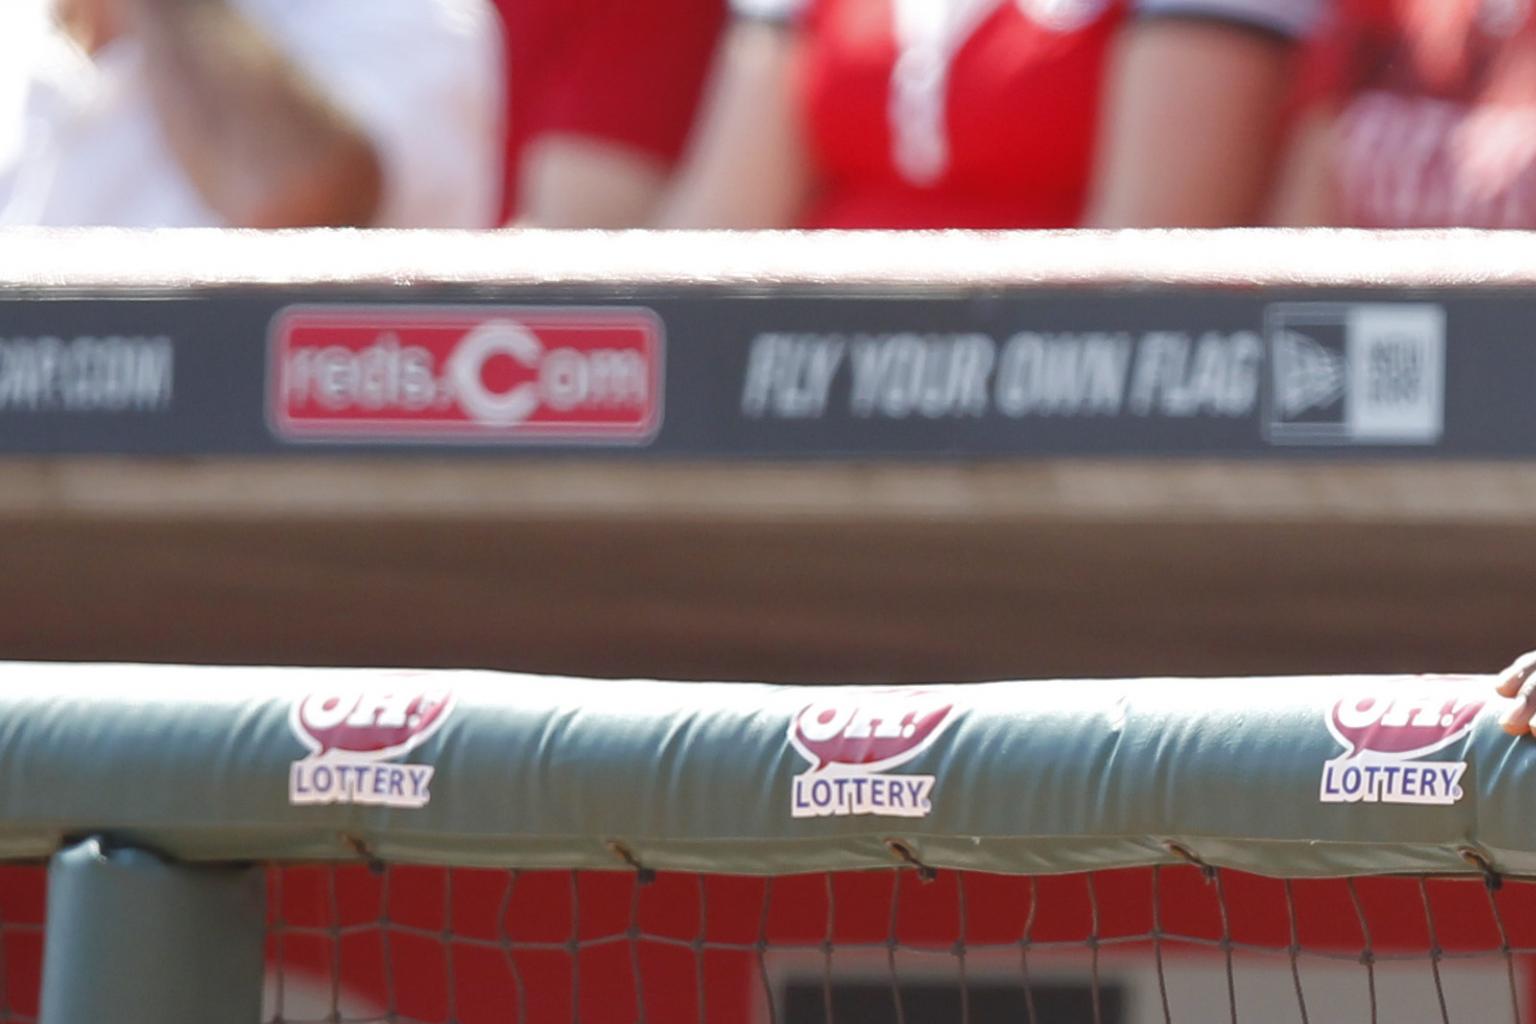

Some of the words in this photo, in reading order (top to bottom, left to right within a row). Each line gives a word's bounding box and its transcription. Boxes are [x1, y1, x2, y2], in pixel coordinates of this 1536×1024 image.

[741, 332, 847, 418] FLY
[851, 332, 995, 418] YOUR
[996, 331, 1130, 418] OWN
[1128, 331, 1263, 417] FLAG
[295, 765, 425, 796] LOTTERY
[796, 778, 924, 807] LOTTERY
[1325, 766, 1457, 797] LOTTERY
